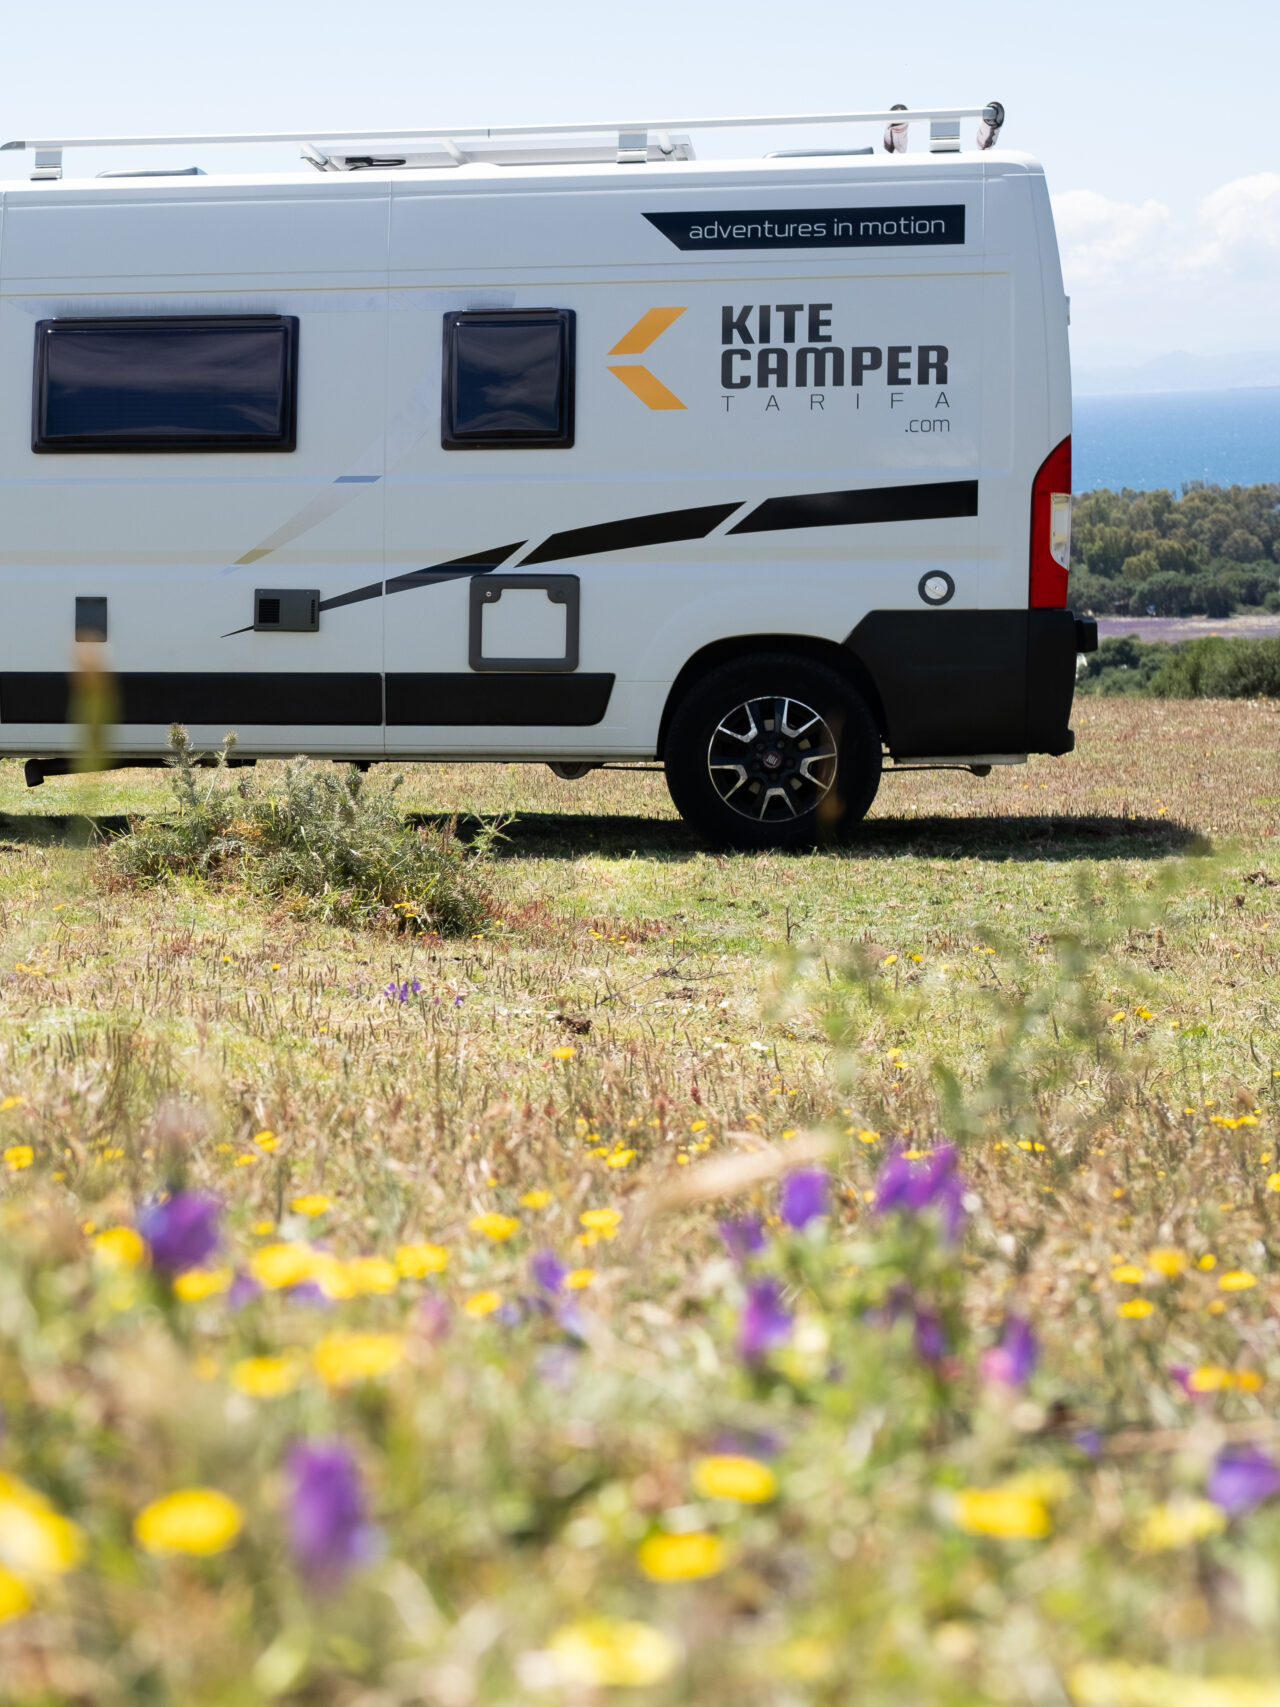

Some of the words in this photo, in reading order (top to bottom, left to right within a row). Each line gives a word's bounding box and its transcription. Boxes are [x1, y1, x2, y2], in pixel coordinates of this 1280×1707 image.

[689, 220, 826, 239] adventures
[833, 218, 853, 236] in
[860, 216, 945, 235] motion
[721, 303, 833, 345] KITE
[720, 345, 949, 389] CAMPER
[721, 392, 950, 412] TARIFA
[905, 419, 950, 433] .com
